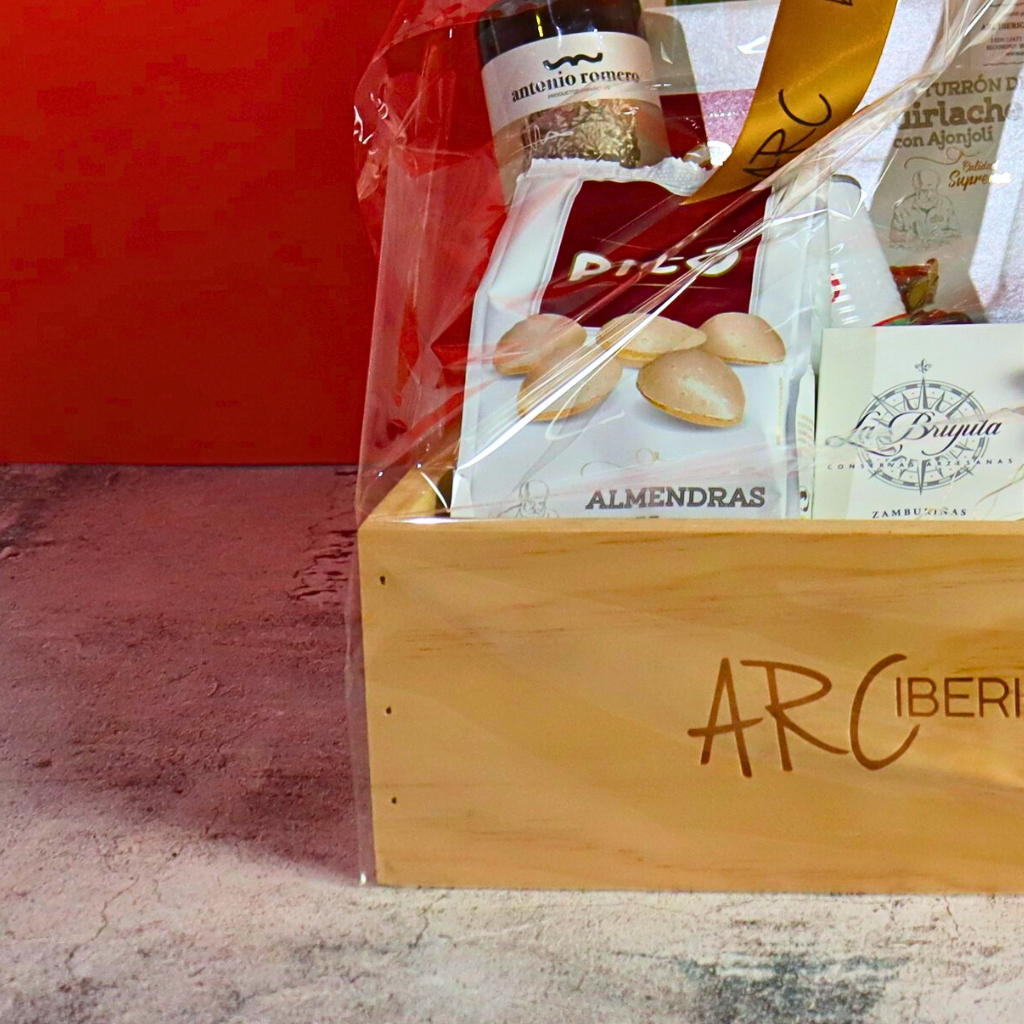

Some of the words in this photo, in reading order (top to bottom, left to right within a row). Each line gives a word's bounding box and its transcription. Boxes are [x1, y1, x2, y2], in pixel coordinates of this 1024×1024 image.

[511, 70, 577, 102] antonio
[580, 70, 641, 84] romero
[925, 74, 1002, 97] TURRÓN
[899, 97, 1023, 130] uirlache
[893, 136, 925, 148] con
[927, 126, 994, 150] Ajonjolí
[585, 486, 765, 509] ALMENDRAS
[688, 654, 920, 778] ARC
